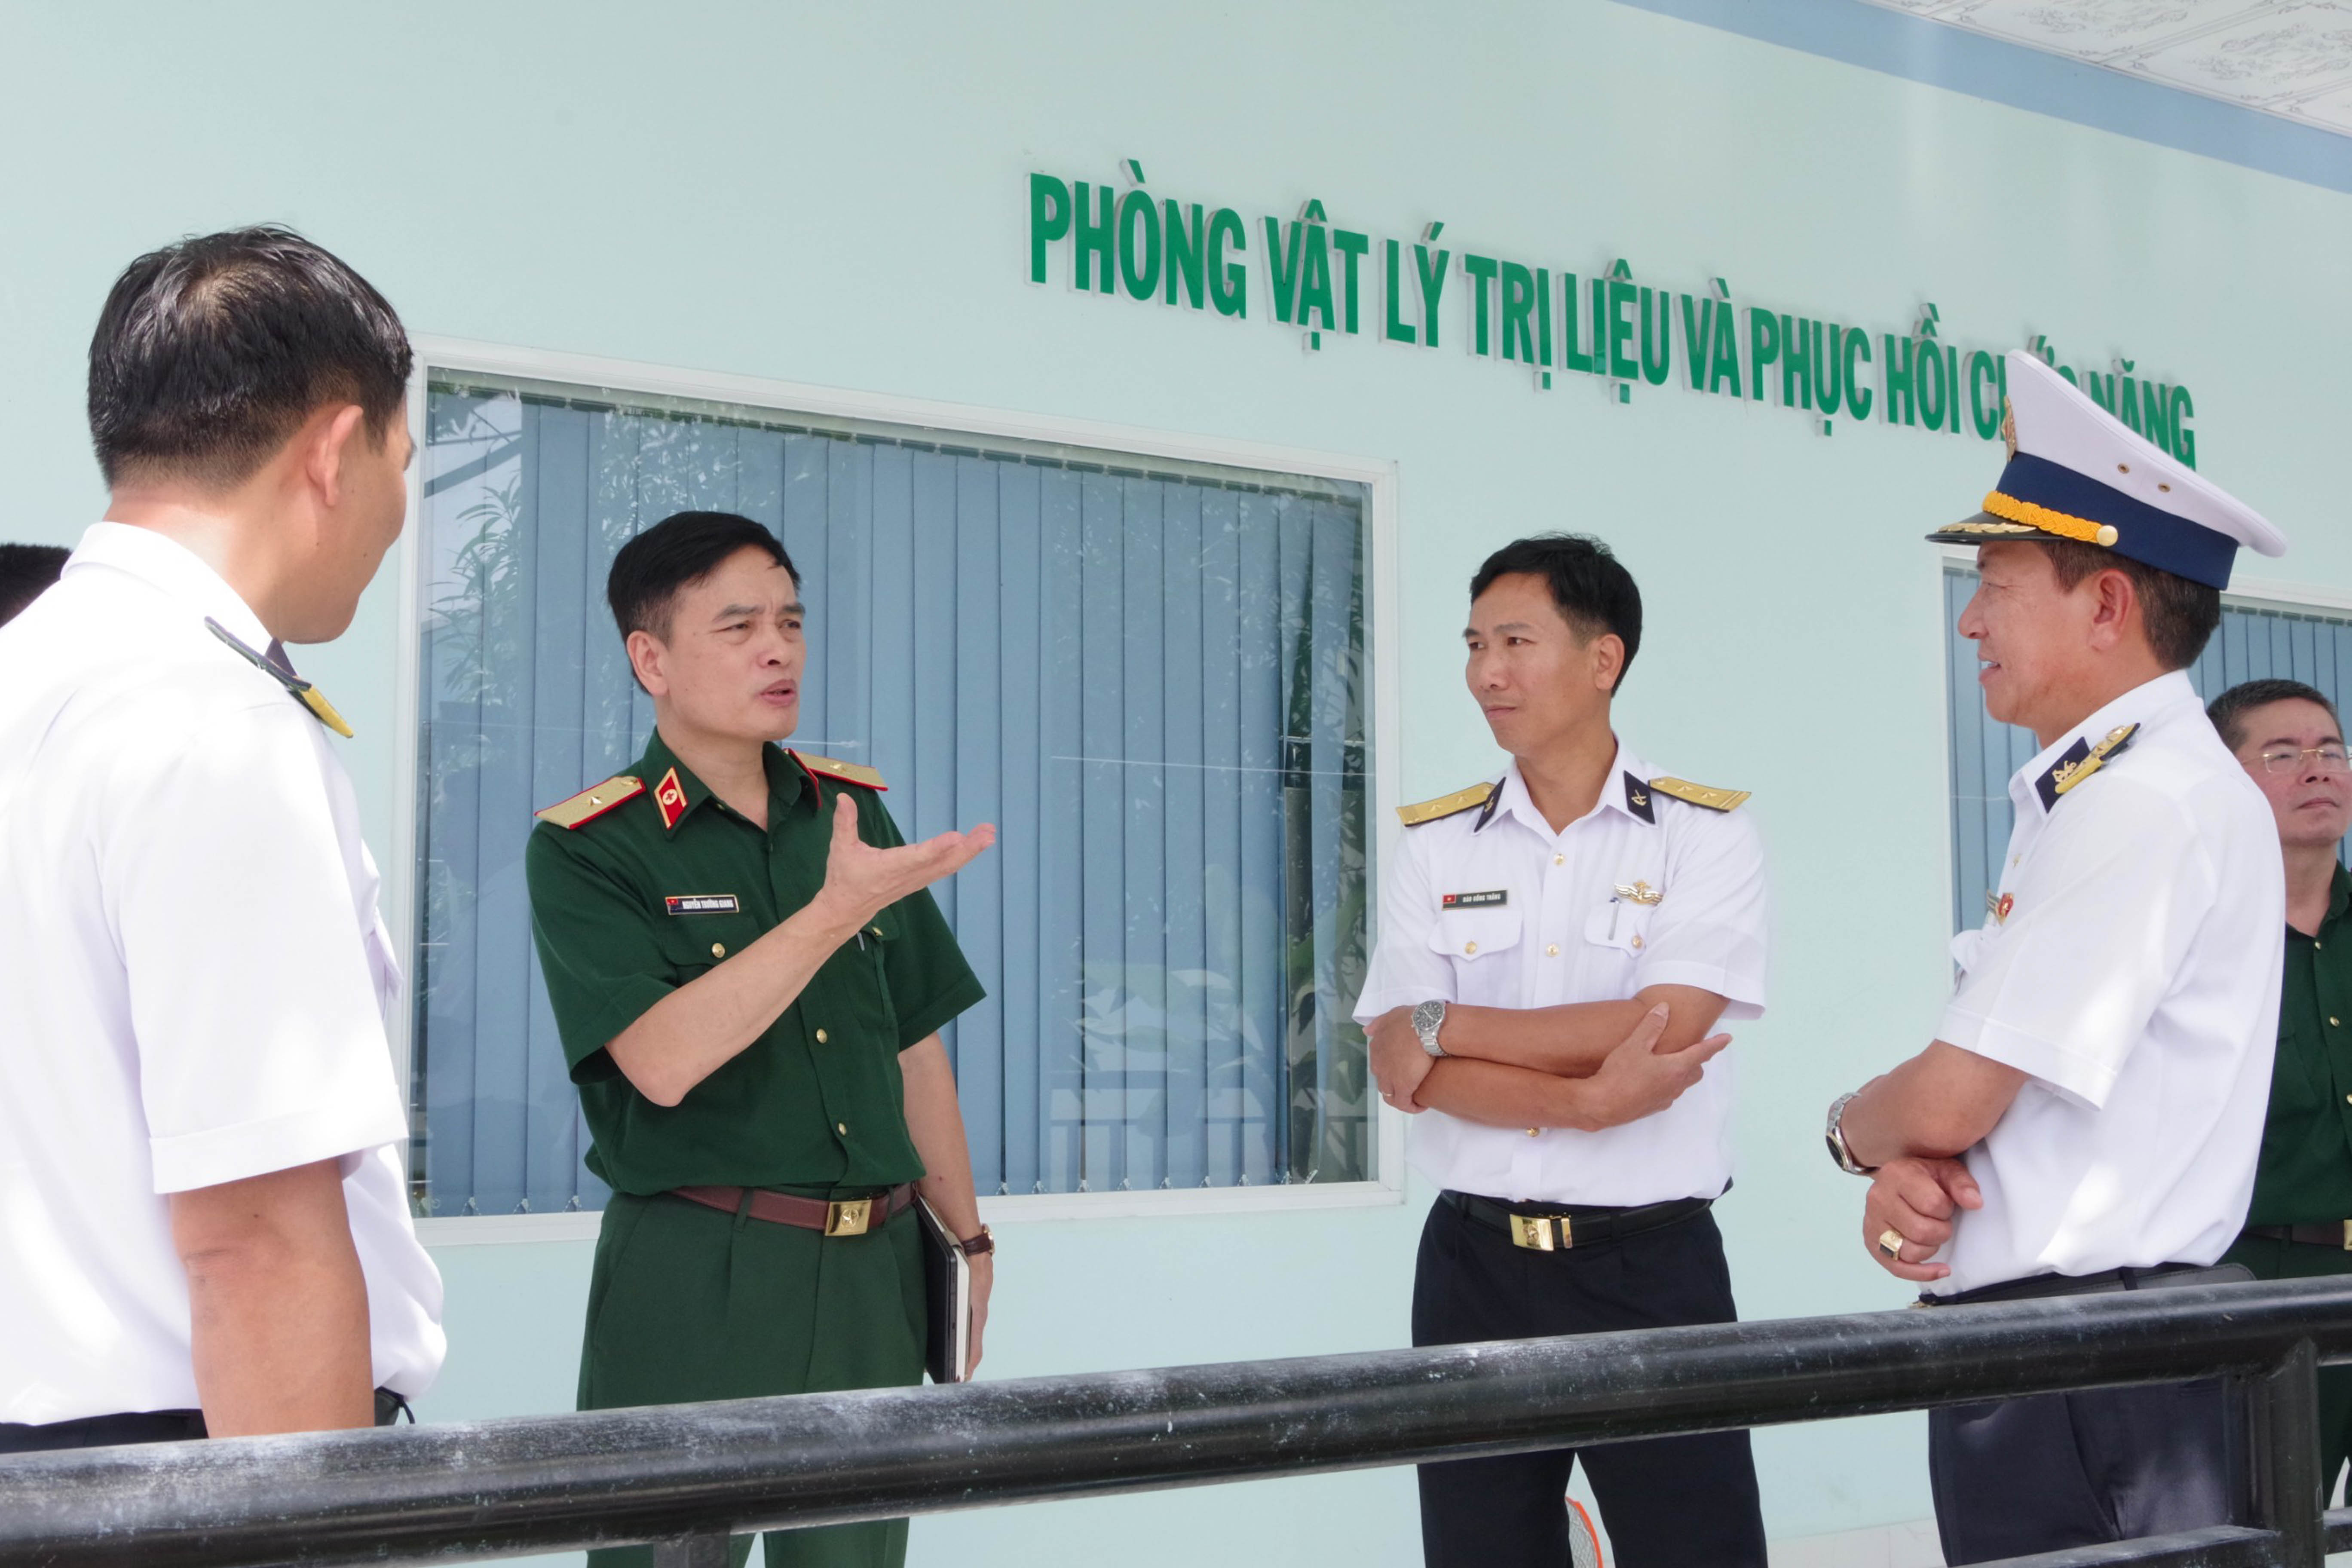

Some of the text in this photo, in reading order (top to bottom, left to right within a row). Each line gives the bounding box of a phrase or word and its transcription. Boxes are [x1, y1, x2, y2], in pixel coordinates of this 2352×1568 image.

[1029, 159, 1248, 320] PHÒNG
[1265, 198, 1369, 351] VẬT
[1386, 221, 1451, 348] LÝ
[1464, 252, 1553, 389] TRỊ
[1564, 258, 1670, 404] LIỆU
[1681, 278, 1742, 398] VÀ
[1750, 306, 1874, 436] PHỤC
[1884, 303, 1962, 434] HỒI
